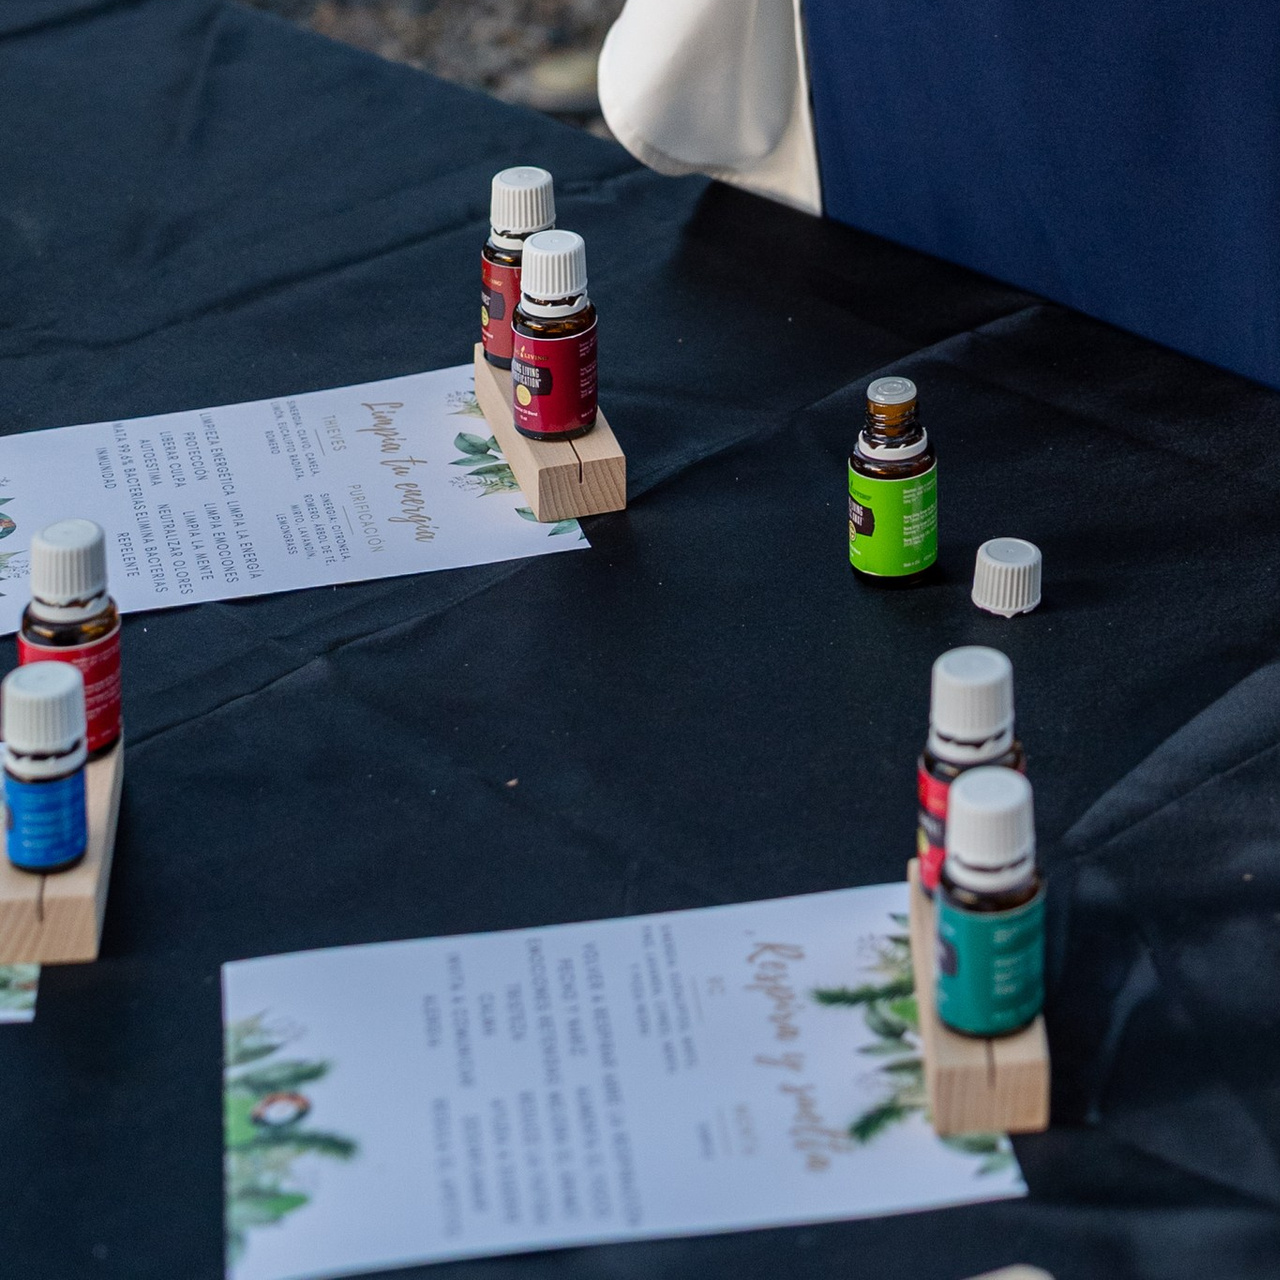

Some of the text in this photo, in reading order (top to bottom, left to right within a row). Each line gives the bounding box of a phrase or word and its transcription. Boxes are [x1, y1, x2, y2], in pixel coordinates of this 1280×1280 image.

[140, 440, 162, 486] AUTOESTIMA
[160, 431, 186, 487] LIBERAR CULPA
[184, 432, 210, 480] PROTECCIÓN
[199, 413, 235, 496] LIMPIEZA ENERGÉTICA
[265, 431, 280, 454] ROMERO
[323, 415, 347, 451] THIEVES
[98, 448, 117, 489] INMUNIDAD
[113, 423, 127, 442] MATA
[124, 468, 146, 510] BACTERIAS
[356, 402, 439, 542] Limpia tu energía
[183, 511, 214, 580] LIMPIA LA MENTE
[204, 503, 239, 582] LIMPIA EMOCIONES
[227, 501, 261, 579] LIMPIA LA ENERGÍA
[276, 514, 298, 554] LEMONGRASS
[292, 505, 304, 525] MIRTO,
[304, 494, 320, 522] ROMERO,
[314, 524, 328, 543] ÁRBOL
[321, 545, 332, 554] DE
[320, 493, 351, 559] SINERGIA: CITRONELA,
[348, 484, 385, 552] PURIFICACIÓN
[117, 533, 140, 577] REPELENTE
[136, 512, 168, 592] ELIMINA BACTERIAS
[158, 504, 193, 594] NEUTRALIZAR OLORES
[736, 937, 819, 1045] Respira
